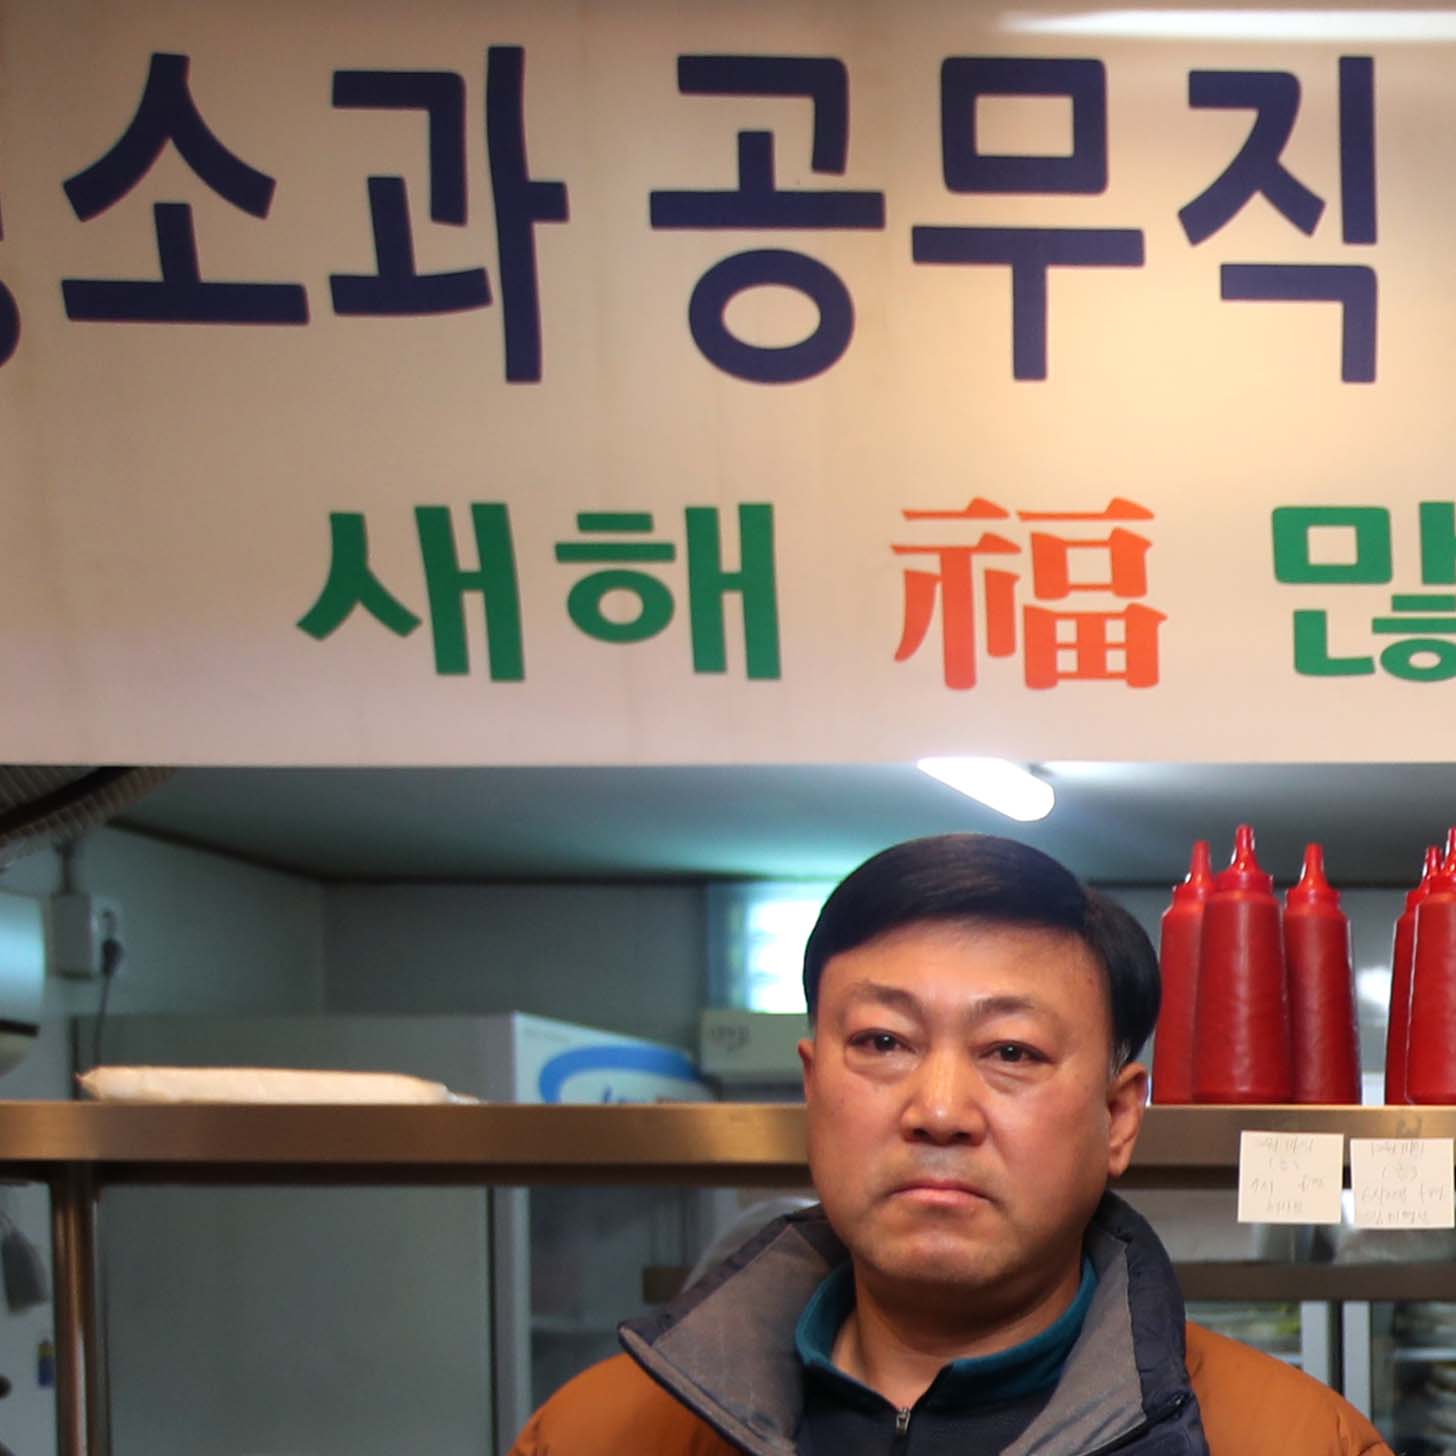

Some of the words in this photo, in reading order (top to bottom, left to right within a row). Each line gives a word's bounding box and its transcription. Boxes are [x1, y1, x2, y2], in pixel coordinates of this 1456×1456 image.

[0, 46, 568, 384] 소과
[649, 54, 1376, 383] 공무직
[297, 501, 781, 682] 새해
[892, 497, 1168, 691] 福
